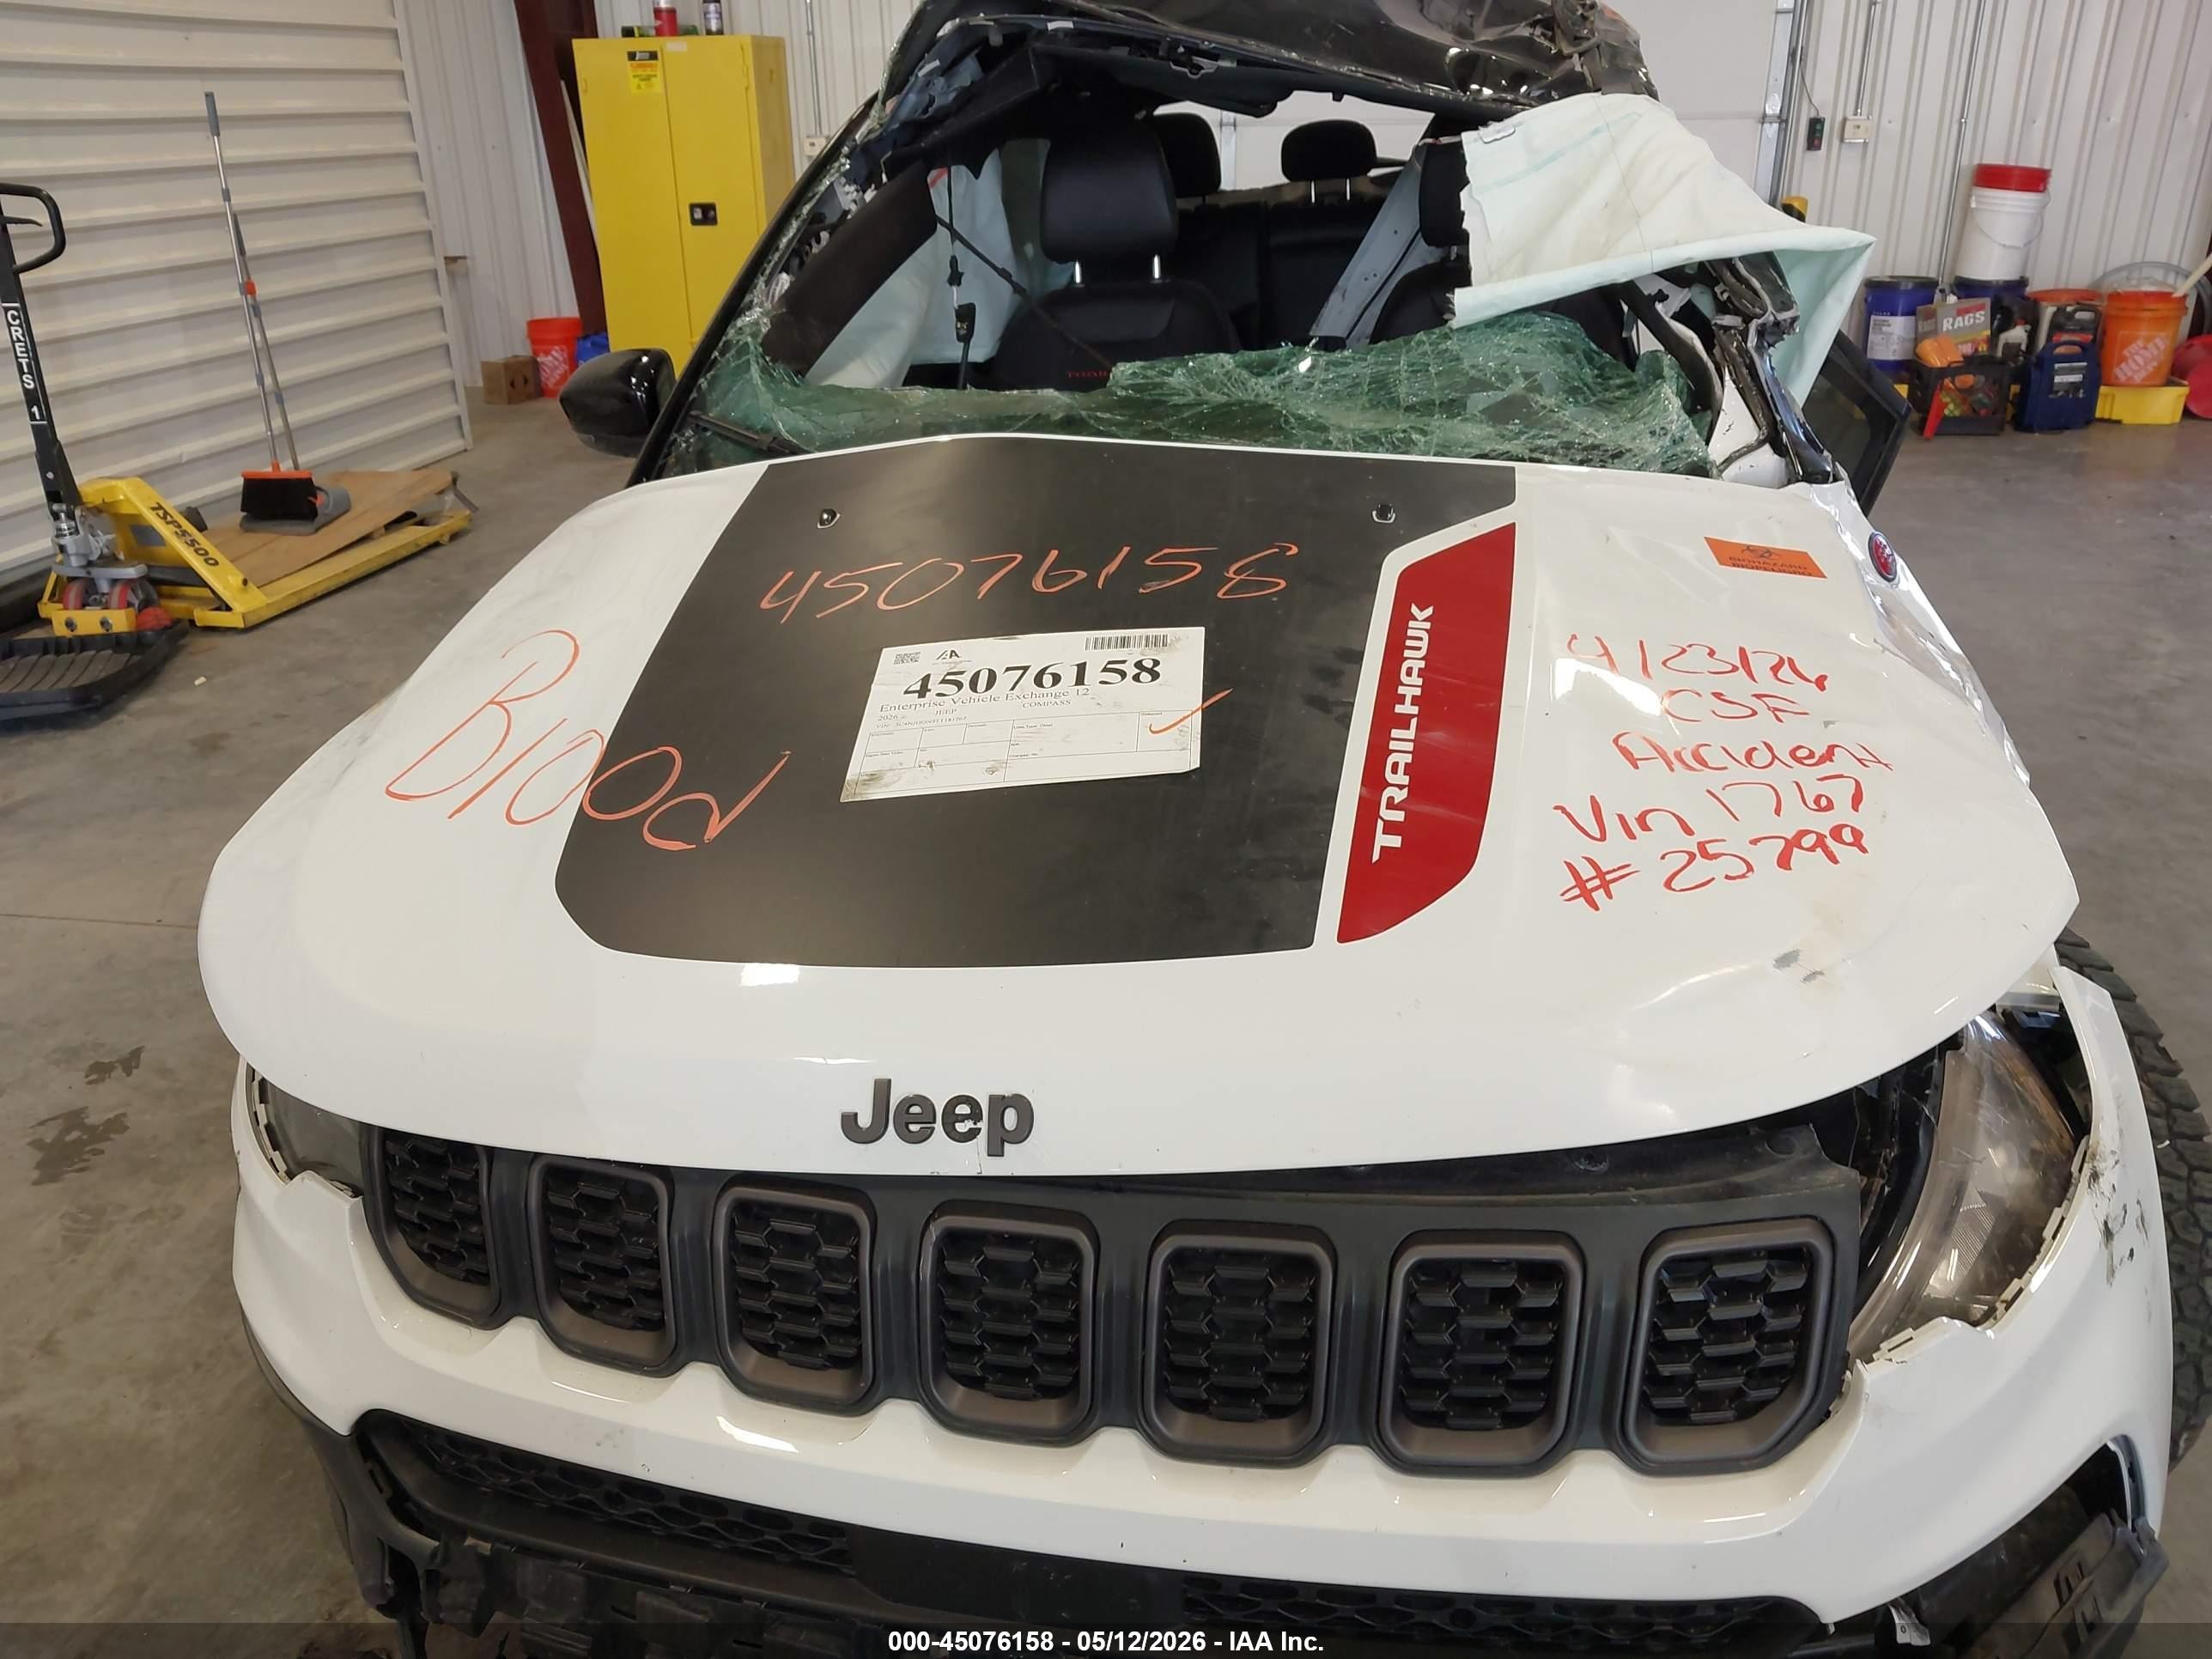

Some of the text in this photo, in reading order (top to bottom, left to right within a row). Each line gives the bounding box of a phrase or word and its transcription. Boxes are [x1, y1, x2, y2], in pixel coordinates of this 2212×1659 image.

[1942, 310, 1985, 332] RAGS
[6, 309, 40, 421] CRETS 1
[149, 502, 220, 568] TSP5500
[760, 543, 1298, 624] 45076158
[879, 687, 1090, 714] Enterprise Vehicle Exchange 12
[902, 657, 1162, 700] 45076158
[1022, 700, 1072, 709] COMPASS
[384, 629, 793, 851] Blood
[1371, 602, 1434, 864] TRAILHAWK
[1705, 773, 1864, 822] 1767
[841, 1078, 1035, 1157] Jeep
